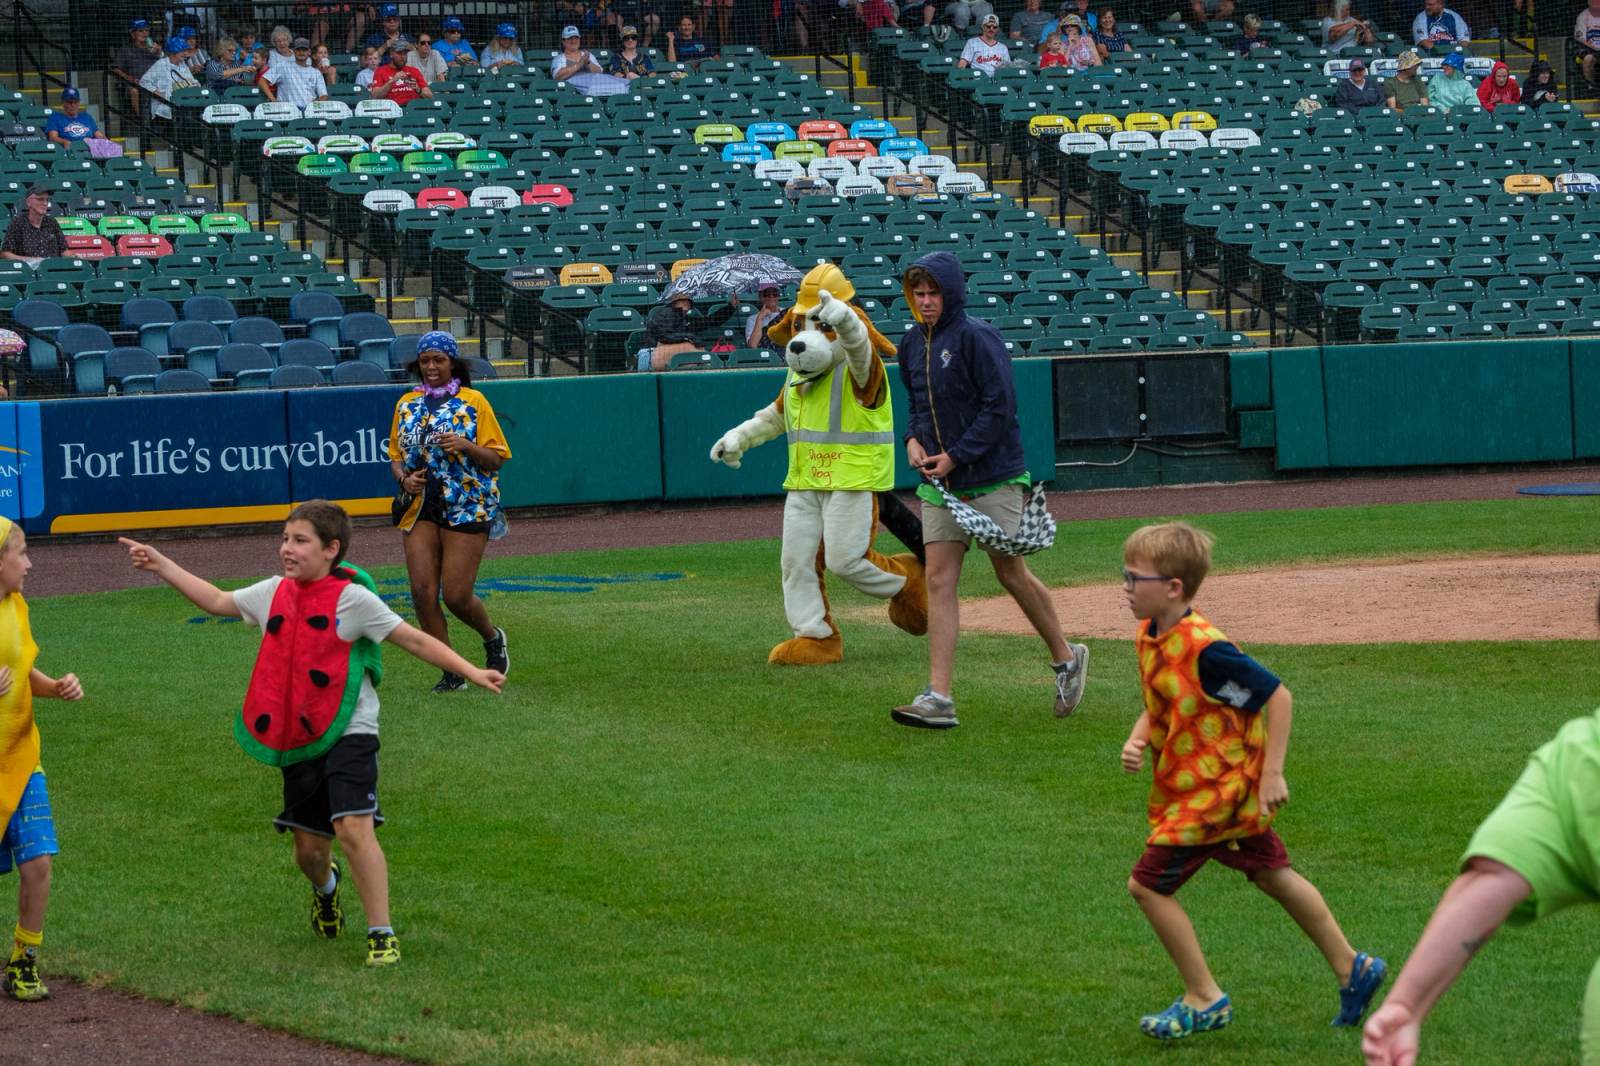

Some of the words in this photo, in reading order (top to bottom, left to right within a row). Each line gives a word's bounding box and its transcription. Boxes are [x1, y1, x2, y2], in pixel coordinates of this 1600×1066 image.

[1031, 127, 1073, 135] DARRELL
[943, 185, 977, 193] CATERPILLAR
[675, 269, 736, 291] ONEAL
[59, 443, 124, 479] For
[130, 437, 211, 476] life's
[220, 428, 391, 472] curveballs
[809, 448, 842, 468] Digger
[812, 467, 832, 487] Dog
